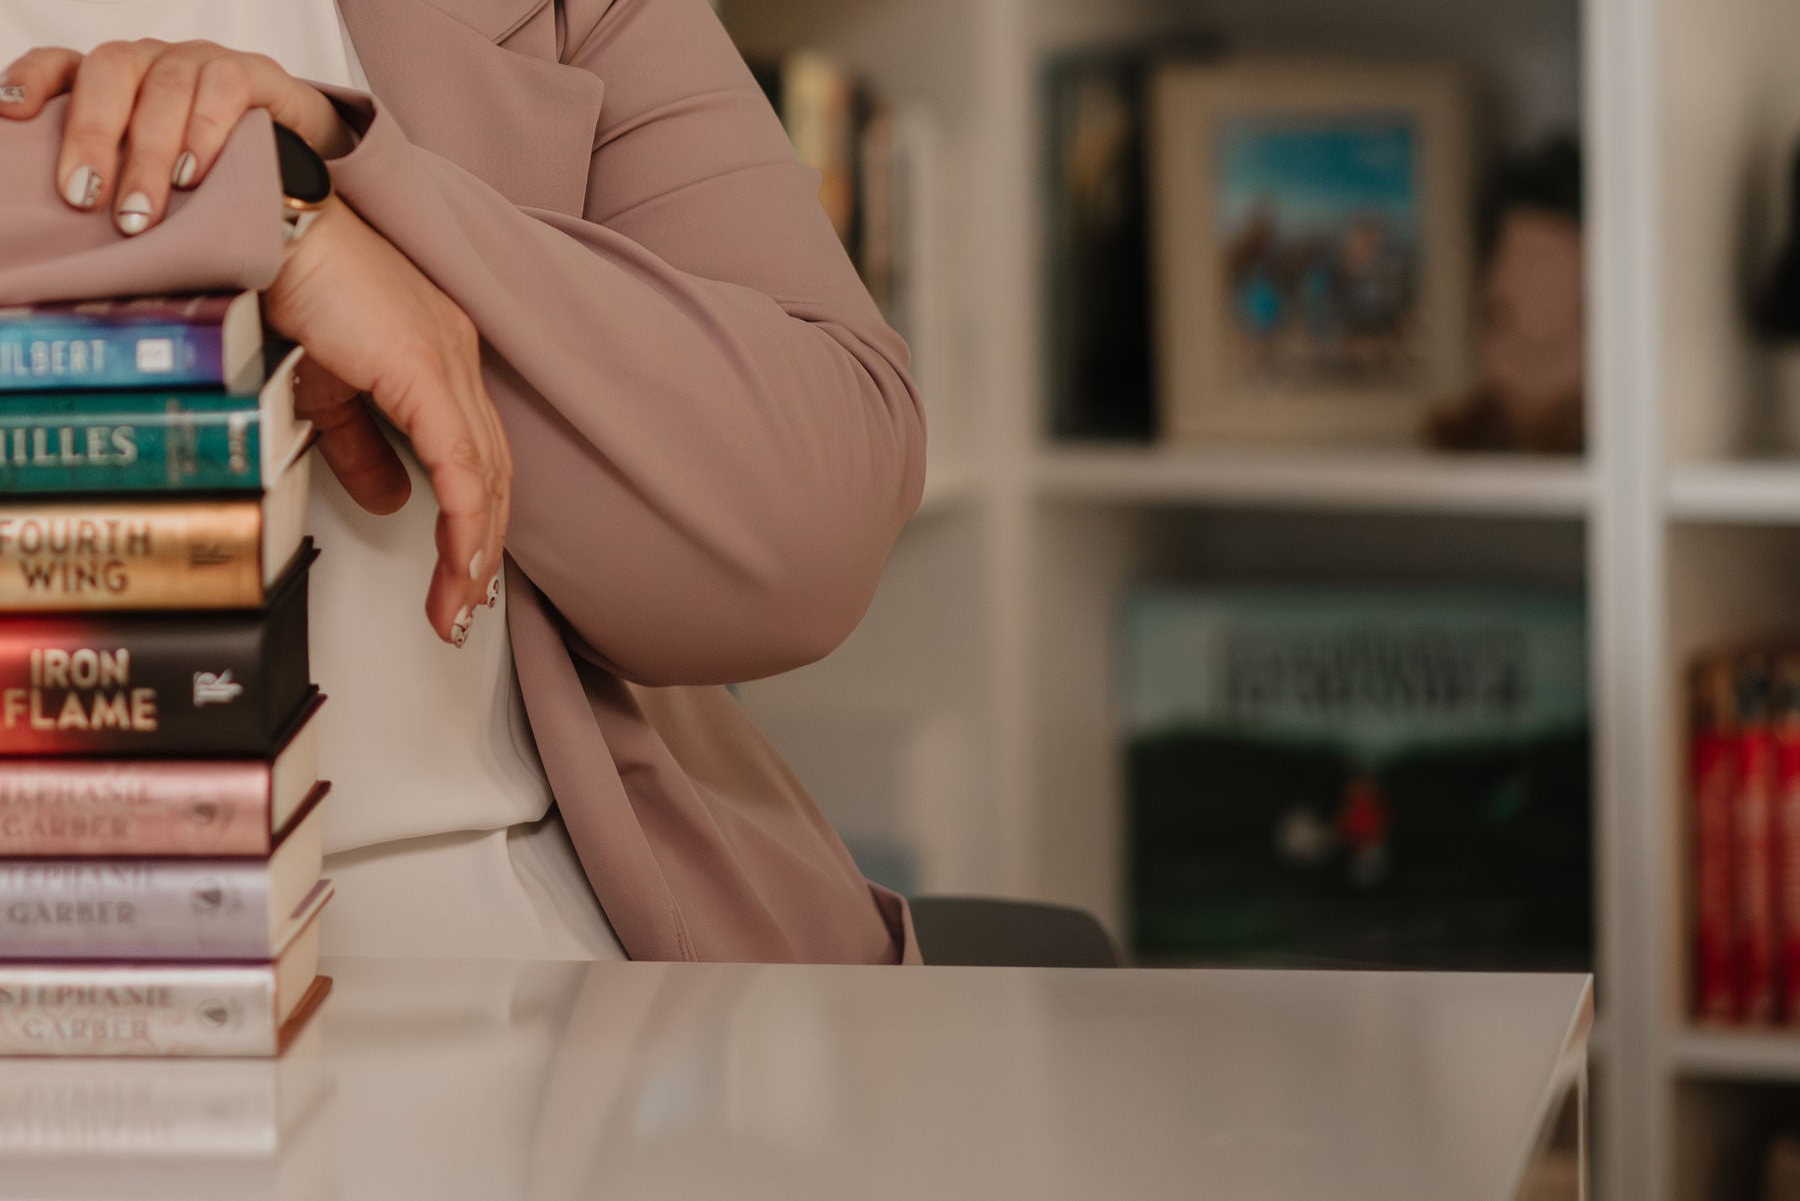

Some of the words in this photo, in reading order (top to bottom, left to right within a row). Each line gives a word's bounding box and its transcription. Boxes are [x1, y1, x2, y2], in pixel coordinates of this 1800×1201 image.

[19, 557, 130, 594] WING
[29, 647, 130, 690] IRON
[3, 687, 158, 732] FLAME
[1, 813, 130, 838] GARBER
[6, 901, 138, 925] GARBER
[21, 1013, 149, 1041] GARBER
